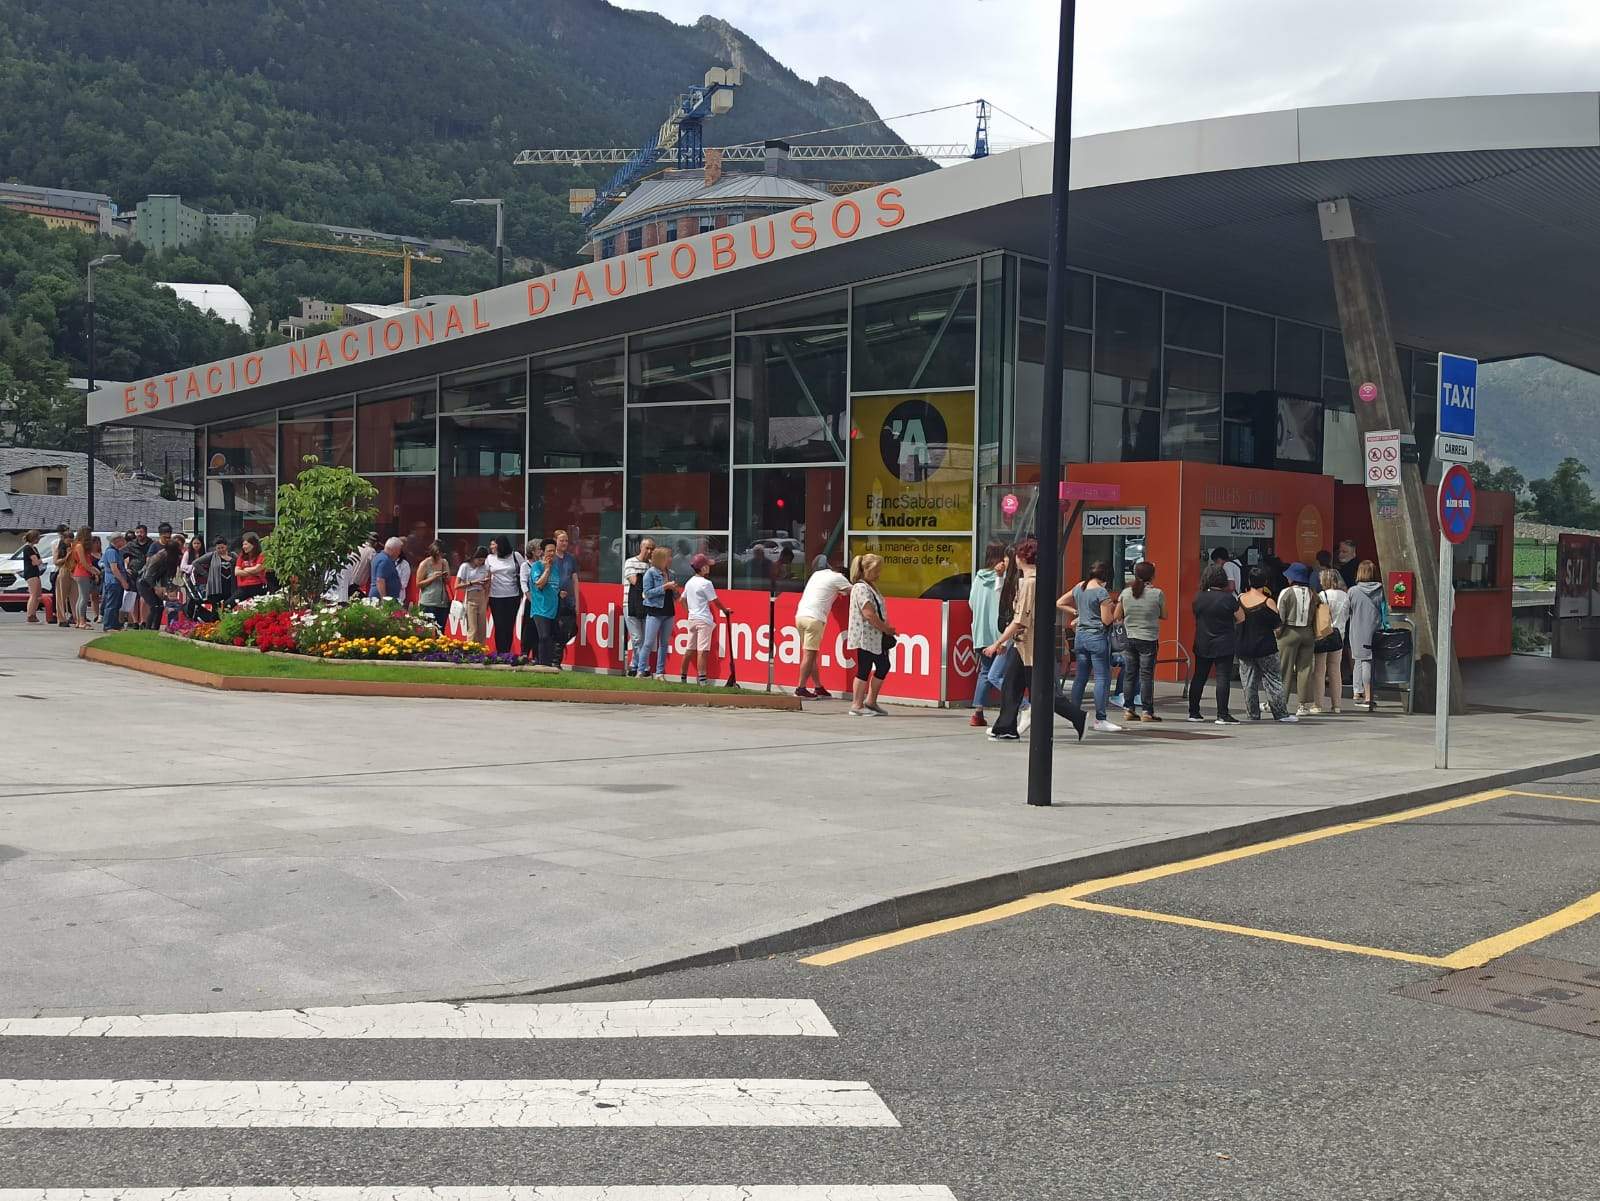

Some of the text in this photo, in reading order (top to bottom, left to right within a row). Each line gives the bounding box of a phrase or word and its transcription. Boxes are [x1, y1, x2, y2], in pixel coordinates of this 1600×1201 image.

[124, 187, 905, 414] ESTACIÓ NACIONAL D'AUTOBUSOS
[1443, 383, 1474, 410] TAXI
[866, 494, 960, 509] BancSabadell
[1087, 514, 1142, 526] Directbus
[1231, 516, 1266, 530] Directbus
[885, 543, 919, 552] manera
[924, 542, 934, 552] de
[884, 555, 919, 565] manera
[921, 554, 933, 564] de
